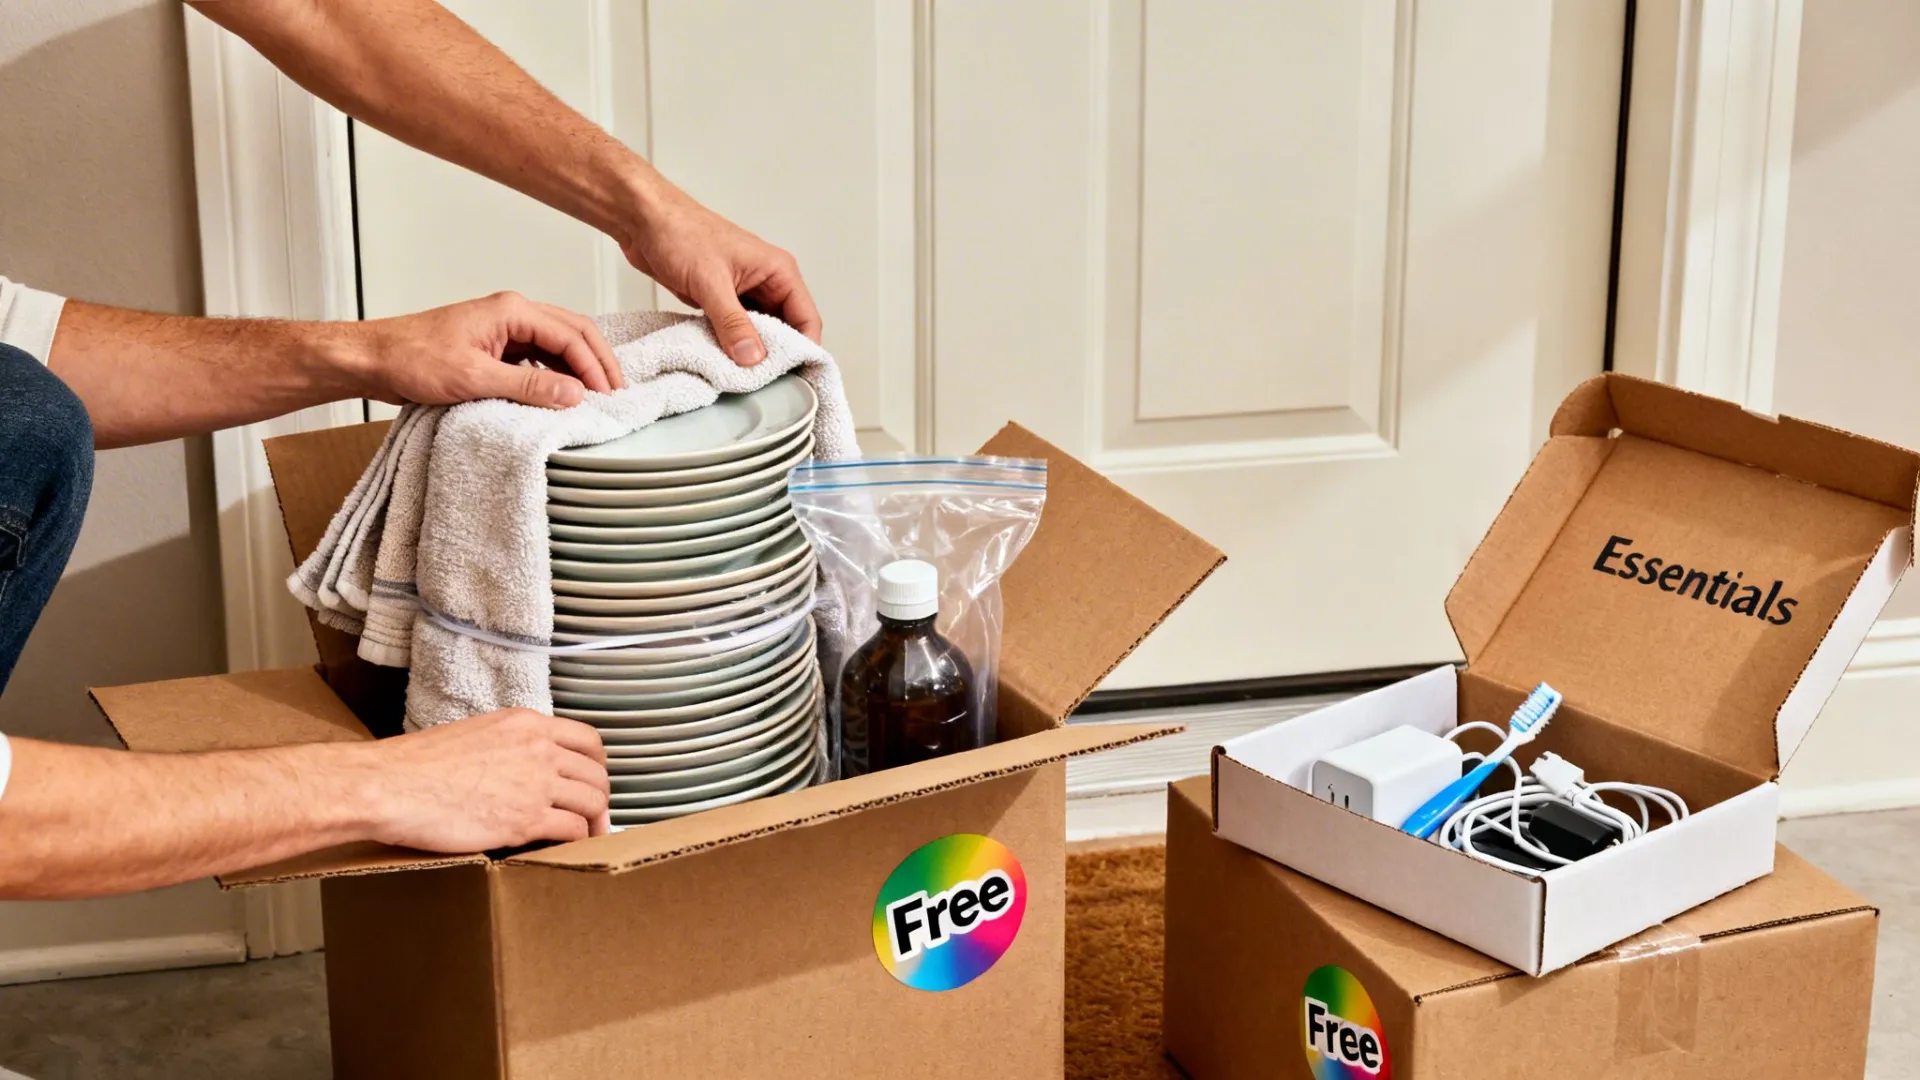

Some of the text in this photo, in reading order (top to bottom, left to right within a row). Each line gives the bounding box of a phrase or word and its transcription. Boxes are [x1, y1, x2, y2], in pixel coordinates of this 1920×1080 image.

[1593, 535, 1799, 626] Essentials
[892, 876, 1009, 955] Free
[1308, 1003, 1379, 1068] Free
